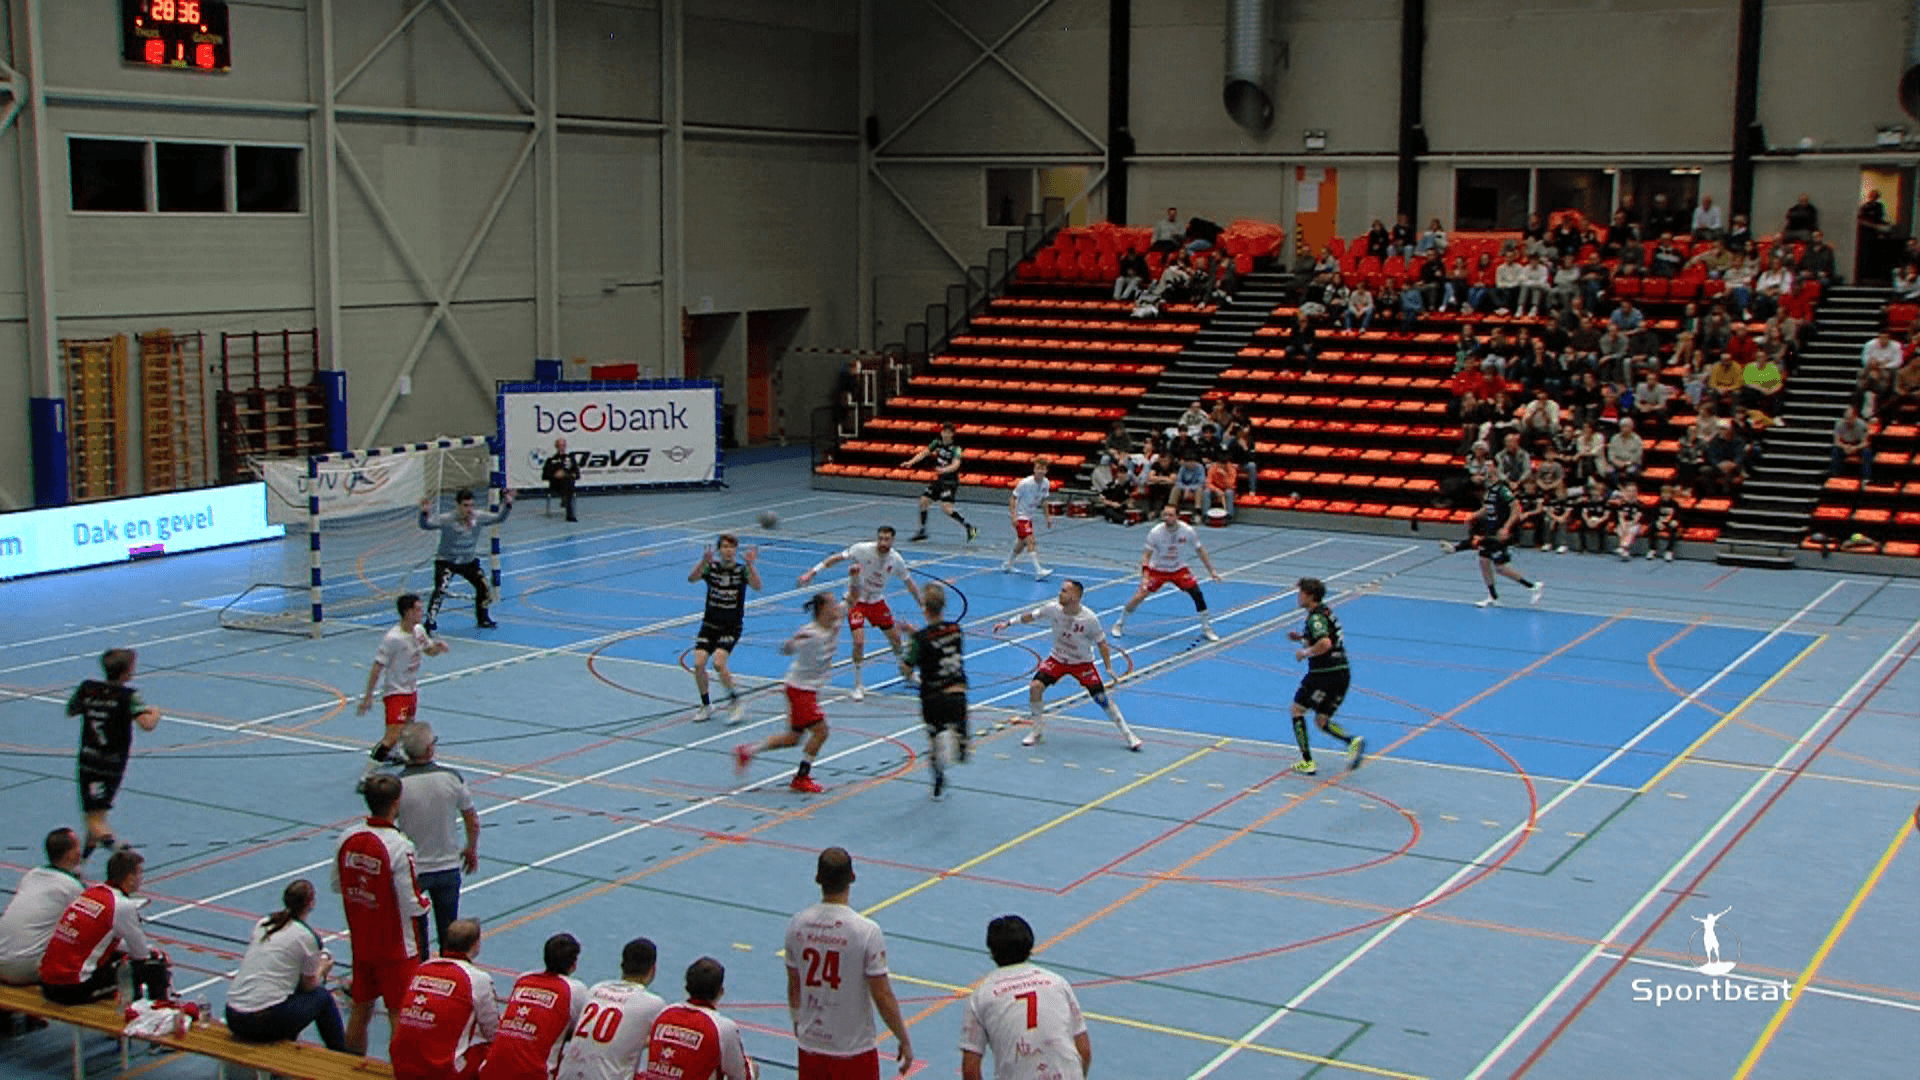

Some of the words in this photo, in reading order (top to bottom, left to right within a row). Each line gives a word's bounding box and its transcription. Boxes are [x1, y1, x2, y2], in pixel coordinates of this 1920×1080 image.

[73, 518, 119, 546] Dak
[123, 519, 152, 540] en
[156, 504, 215, 541] gevel
[802, 947, 841, 990] 24
[575, 1001, 623, 1043] 20
[1014, 990, 1038, 1029] 7
